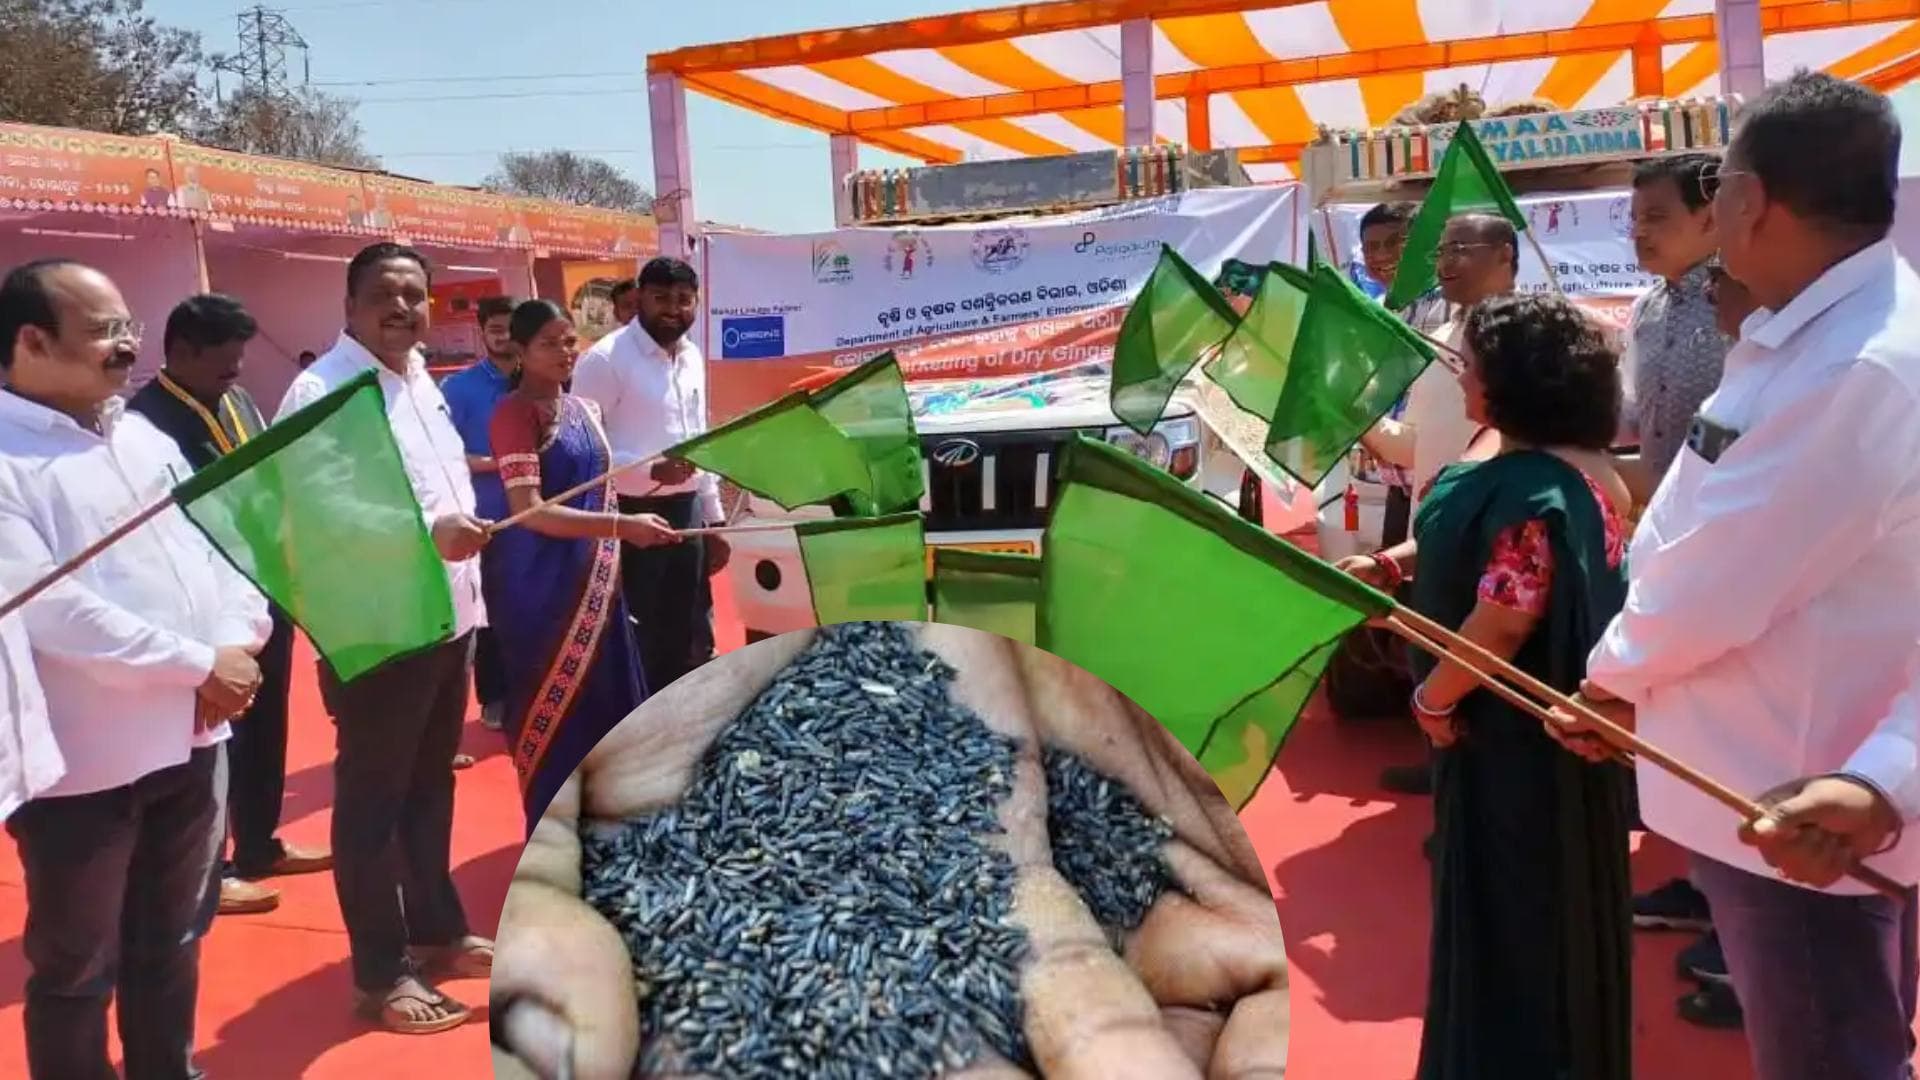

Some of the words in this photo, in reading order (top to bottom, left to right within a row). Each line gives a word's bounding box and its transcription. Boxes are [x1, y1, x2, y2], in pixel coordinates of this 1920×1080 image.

[836, 329, 899, 347] Department
[902, 325, 914, 337] of
[916, 317, 978, 336] Agriculture
[981, 314, 990, 326] &
[1010, 346, 1045, 368] Dry
[1051, 342, 1117, 365] Ginge
